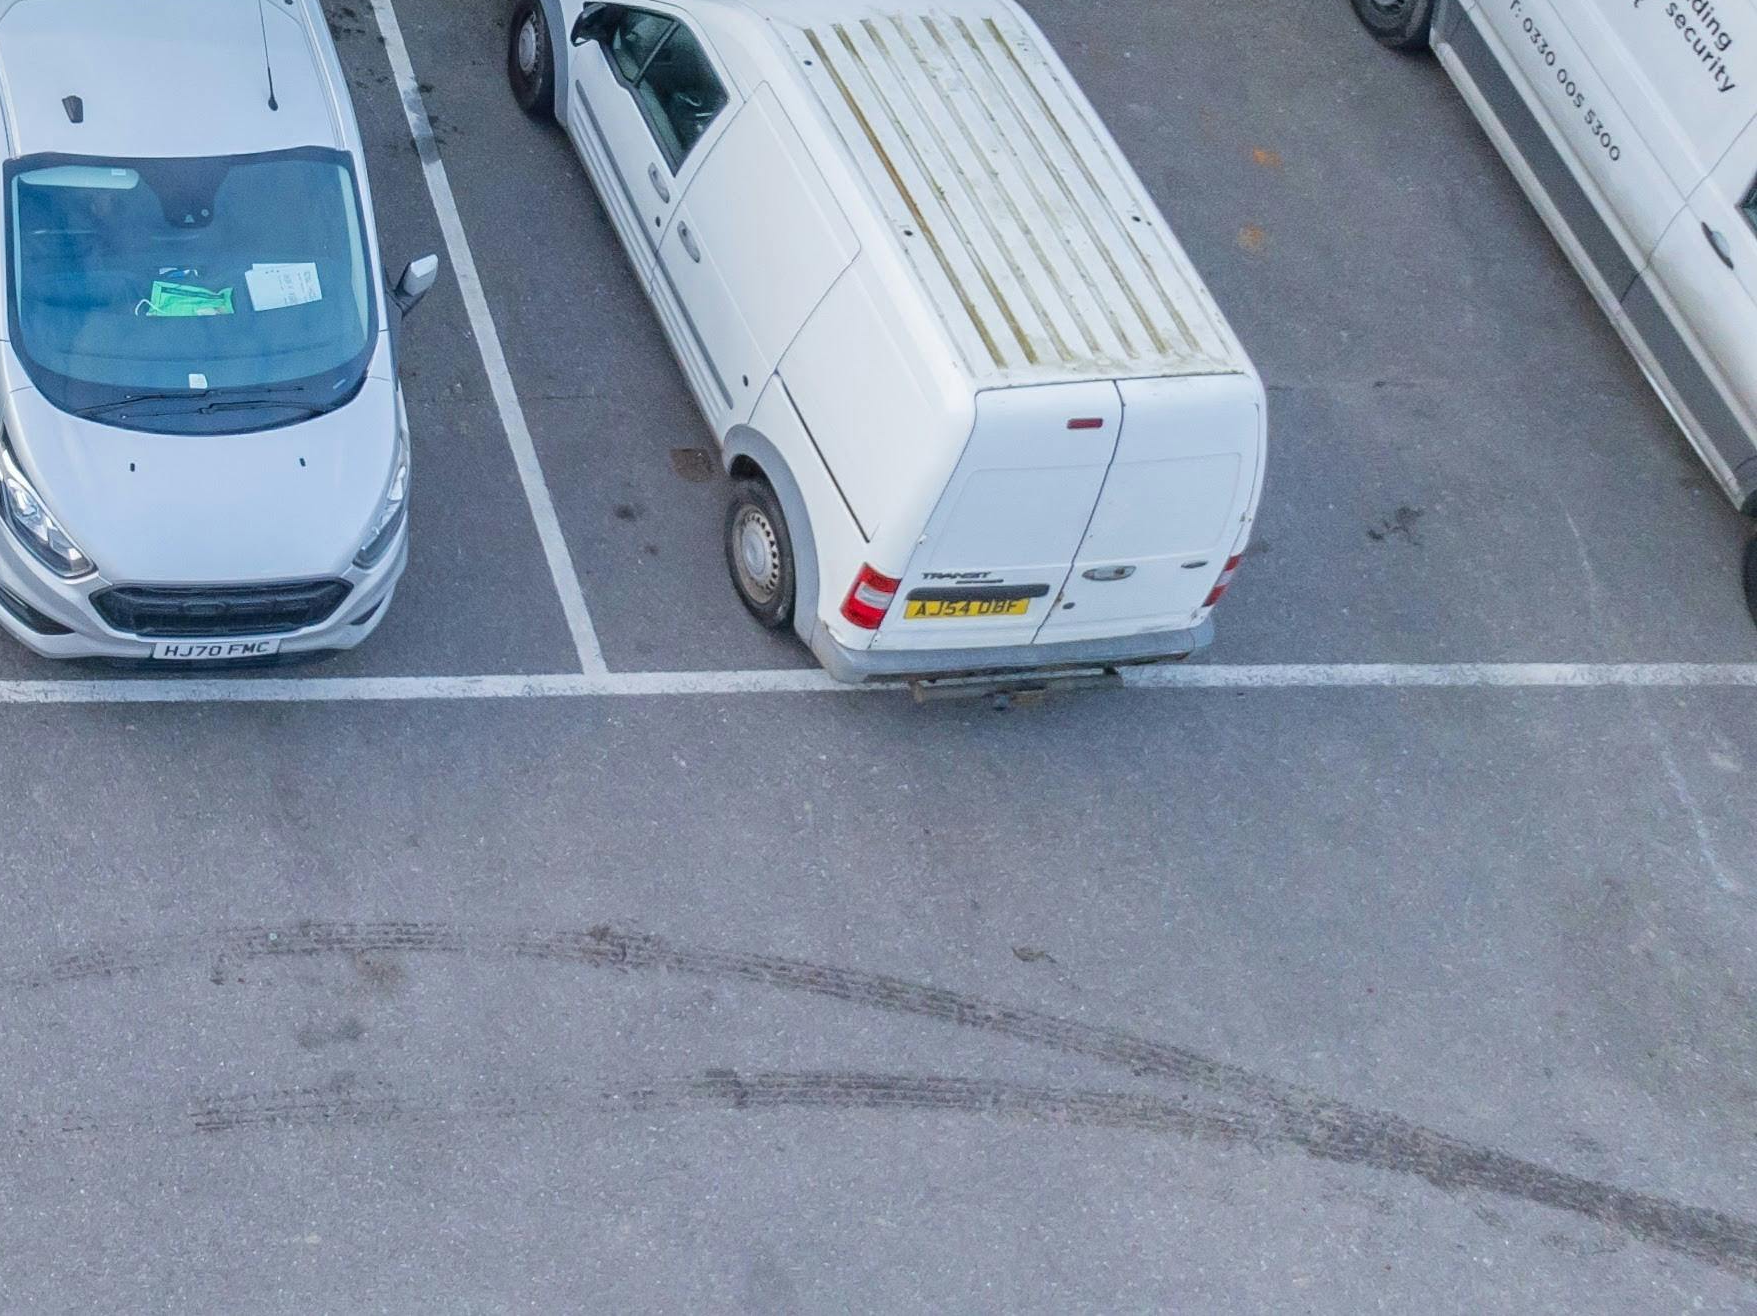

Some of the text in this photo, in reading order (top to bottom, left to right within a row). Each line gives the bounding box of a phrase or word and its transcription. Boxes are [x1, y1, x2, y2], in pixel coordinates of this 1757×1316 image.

[1665, 2, 1736, 94] security
[1522, 17, 1556, 67] 0330
[1556, 68, 1586, 108] 005
[1584, 108, 1621, 161] 5300
[914, 600, 971, 617] AJ54
[164, 641, 270, 657] HJ70 FMC
